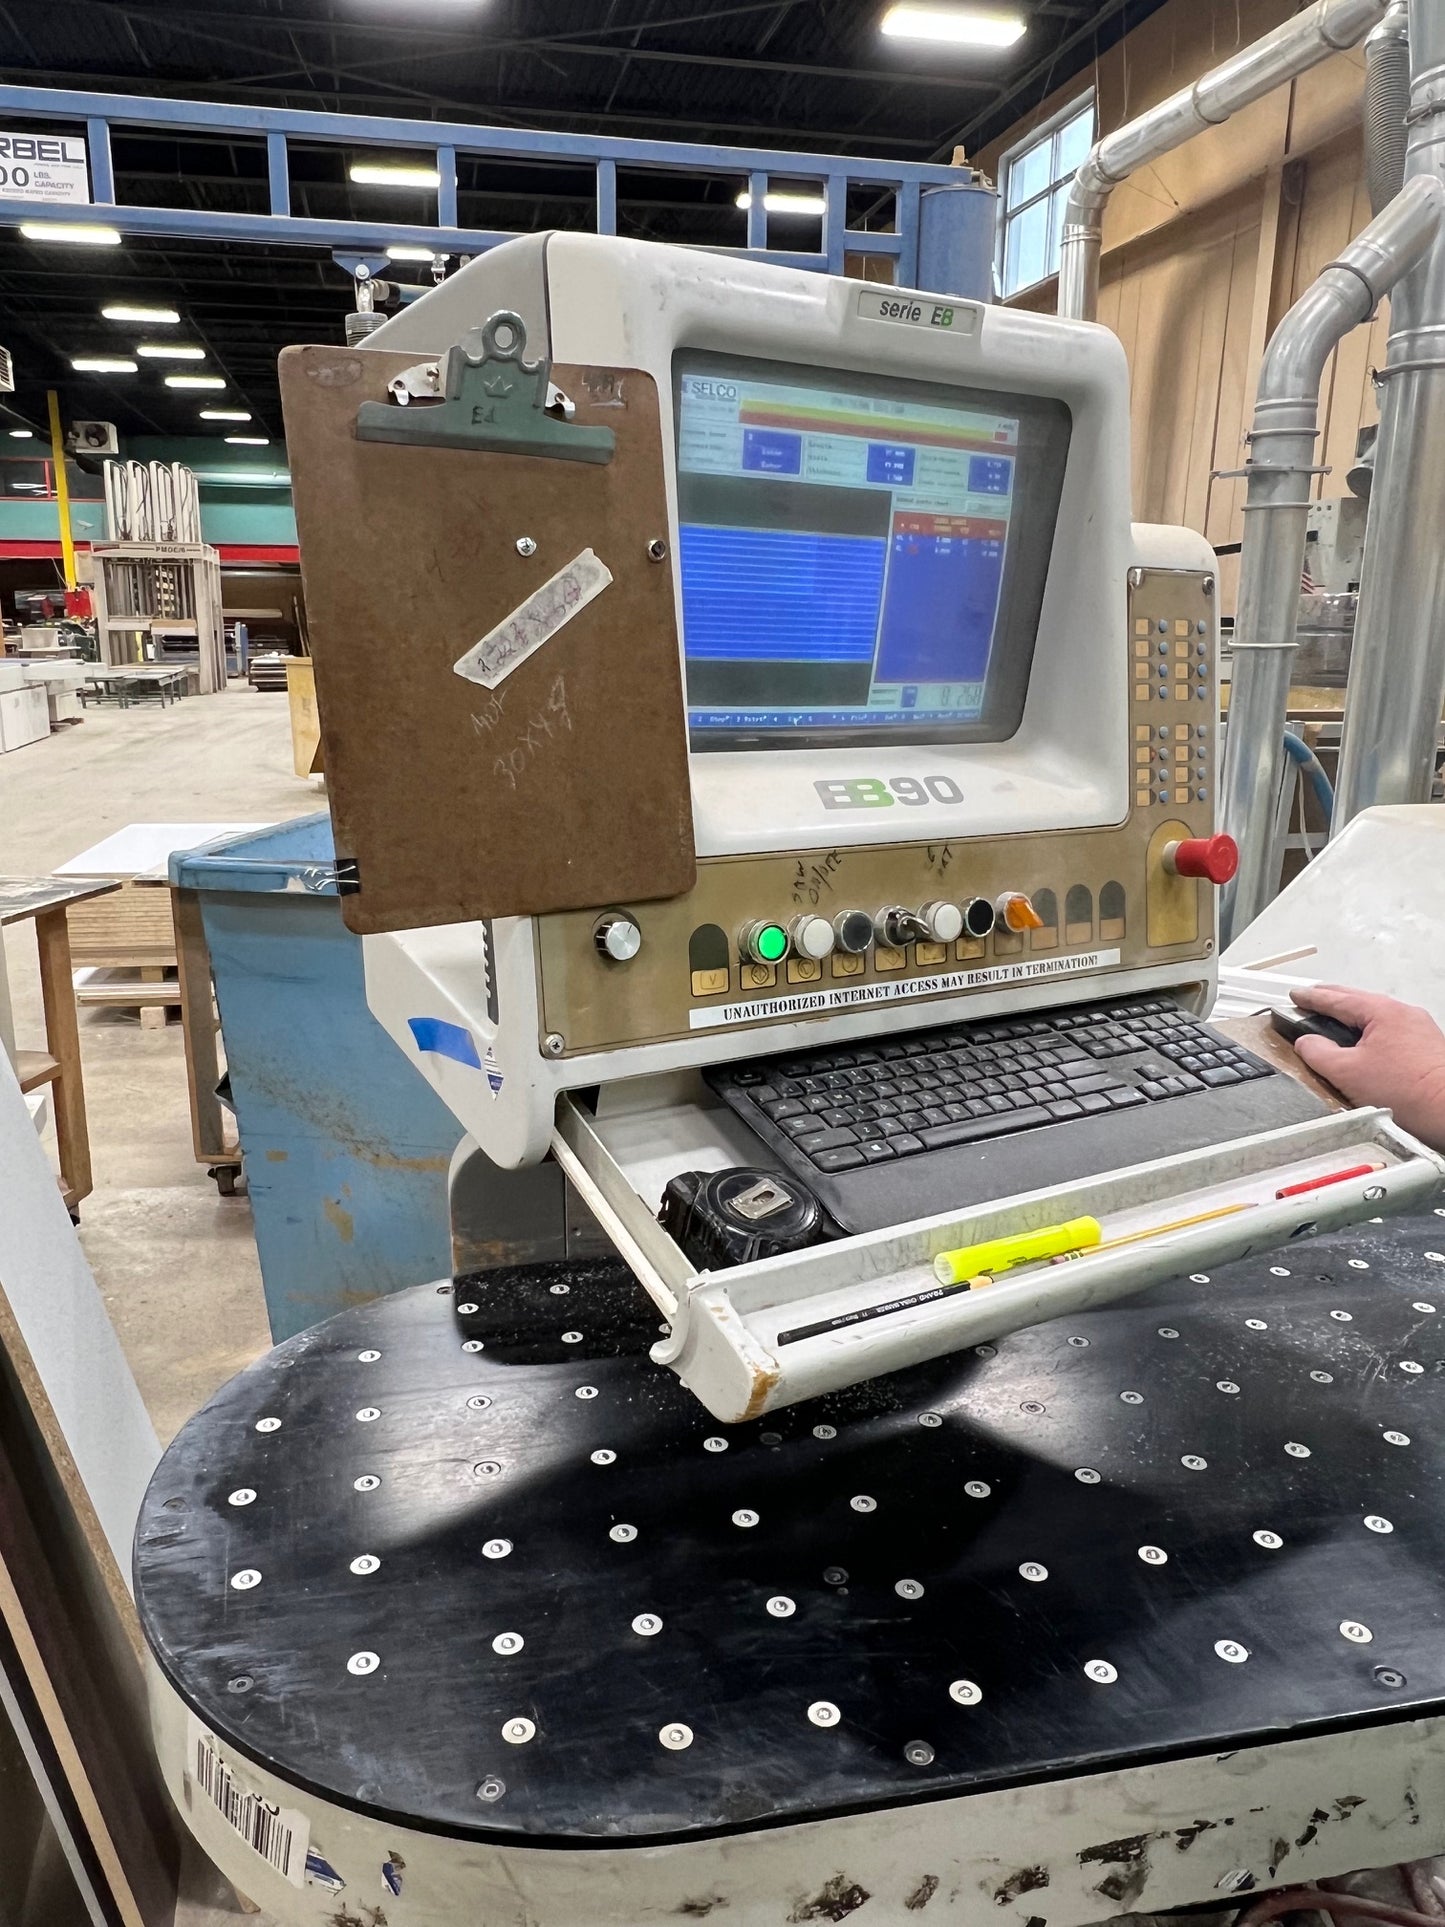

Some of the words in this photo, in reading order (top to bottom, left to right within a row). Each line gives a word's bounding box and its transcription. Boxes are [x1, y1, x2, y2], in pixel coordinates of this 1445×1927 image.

[879, 300, 921, 321] serie
[930, 306, 954, 327] EB
[691, 381, 737, 400] SELCO
[812, 775, 965, 810] EB90
[723, 994, 826, 1022] UNAUTHORIZED
[829, 985, 891, 1006] INTERNET
[893, 978, 939, 996] ACCESS
[941, 974, 965, 989] MAY
[967, 968, 1010, 985] RESULT
[1012, 966, 1024, 978] IN
[1025, 954, 1099, 976] TERMINATION!
